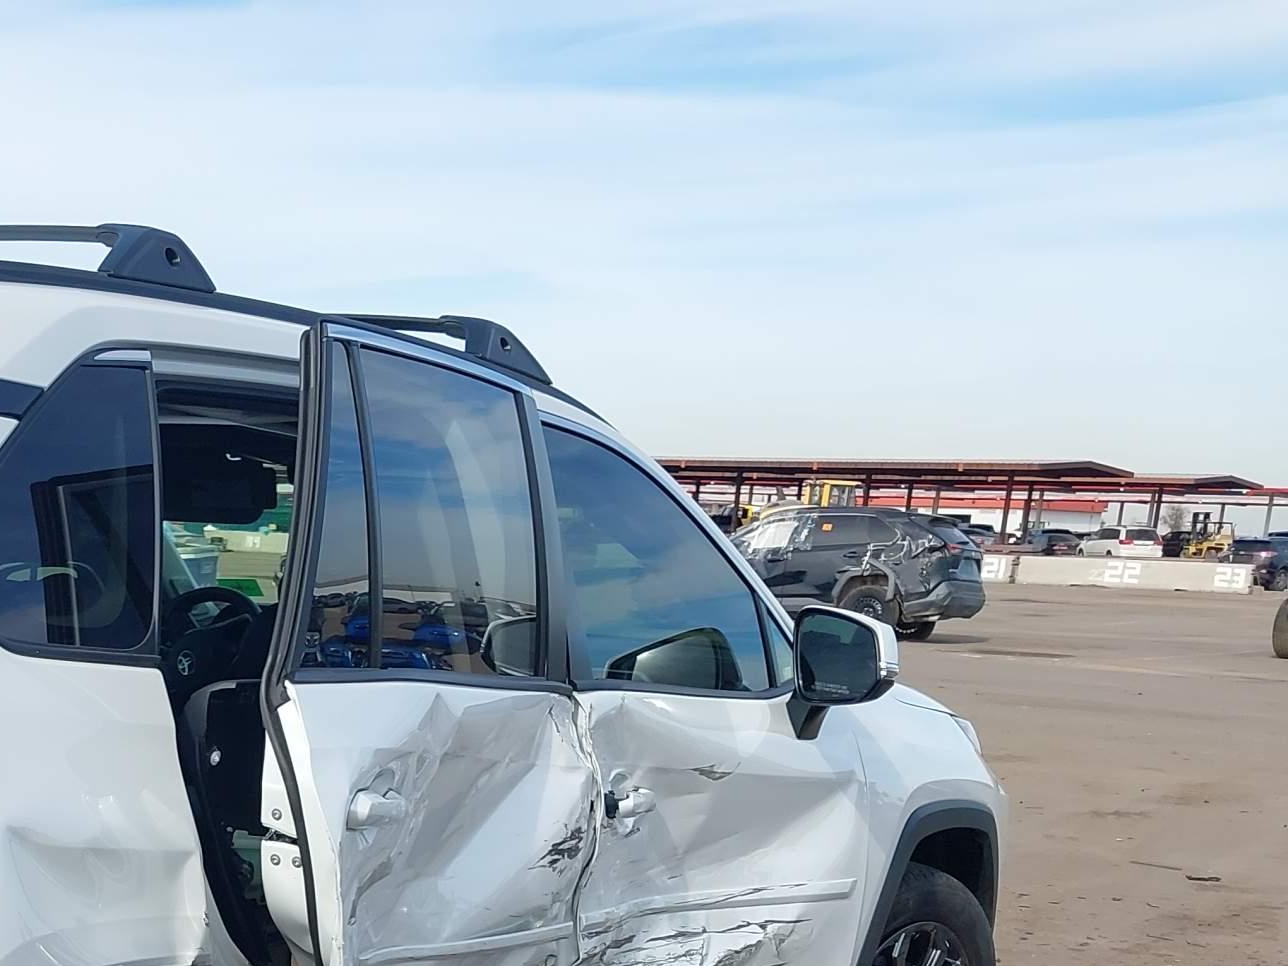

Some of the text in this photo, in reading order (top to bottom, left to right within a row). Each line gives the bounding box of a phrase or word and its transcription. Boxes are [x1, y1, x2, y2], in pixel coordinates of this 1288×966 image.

[981, 558, 1007, 579] 21
[1104, 561, 1142, 584] 22
[1214, 566, 1247, 588] 23
